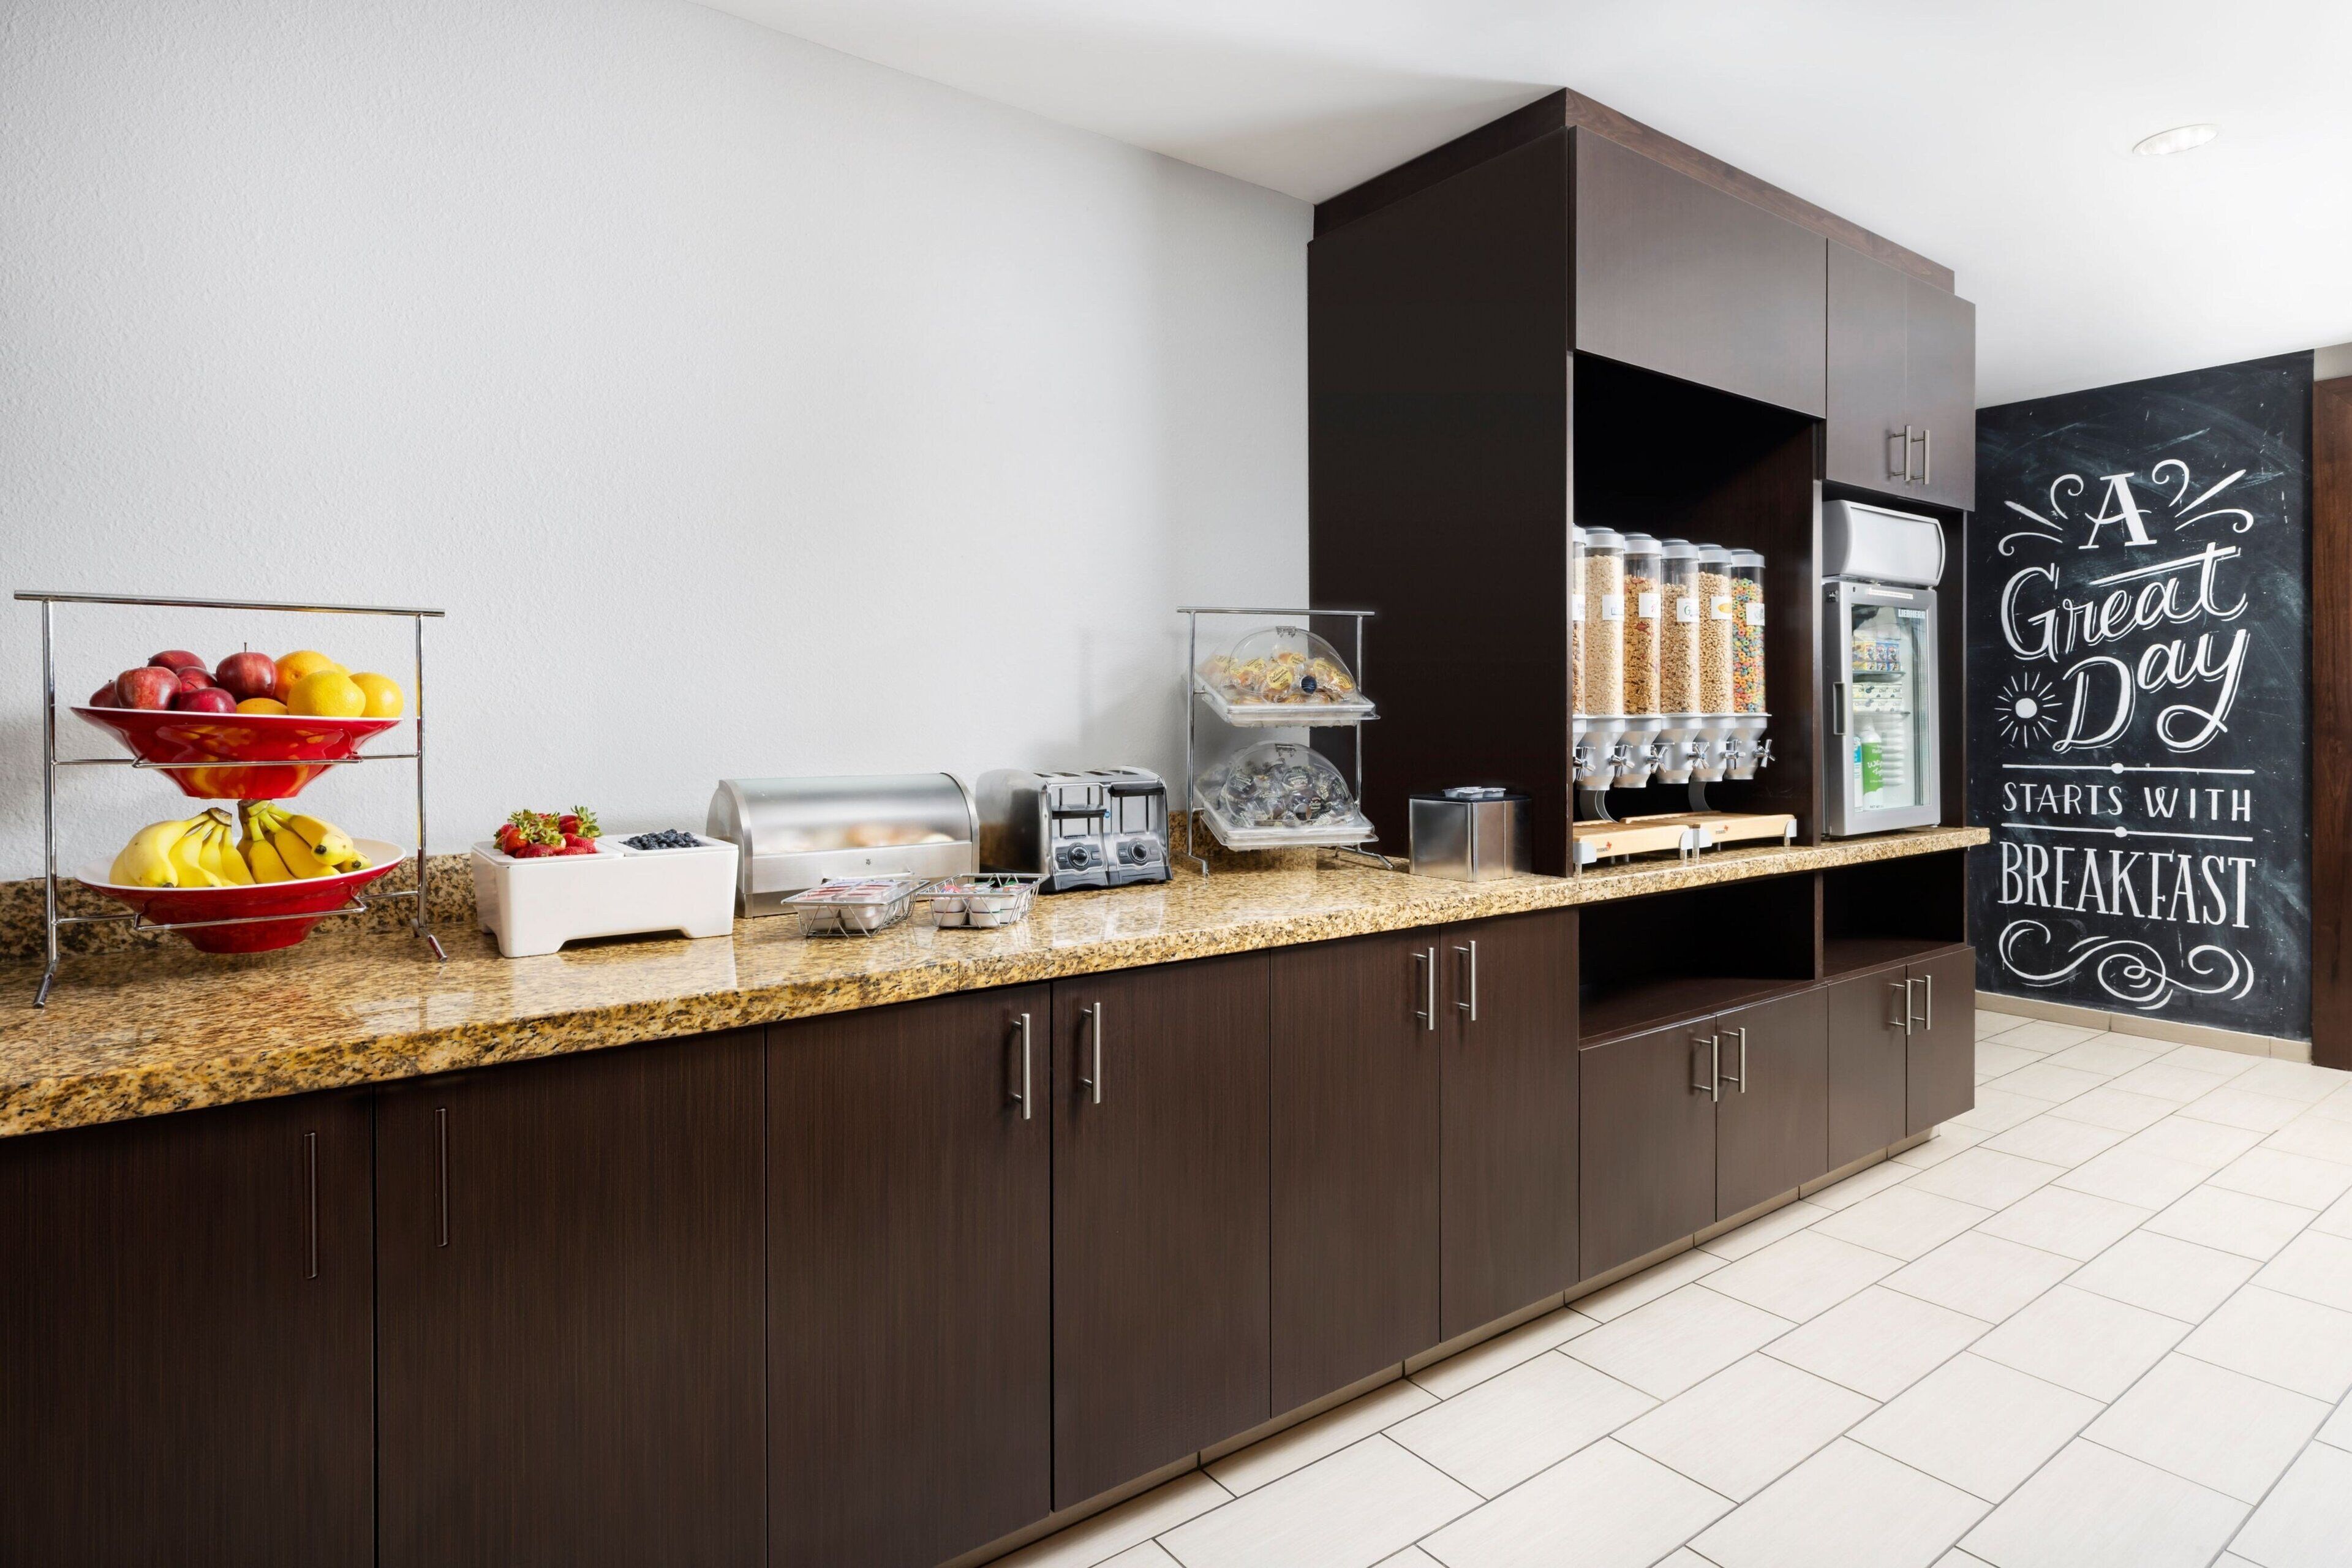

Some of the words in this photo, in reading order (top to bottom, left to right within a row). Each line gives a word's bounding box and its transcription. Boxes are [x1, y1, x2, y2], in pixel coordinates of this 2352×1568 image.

[2079, 472, 2157, 549] A
[2000, 541, 2248, 663] Great
[2052, 628, 2252, 753] Day
[2002, 782, 2123, 815] STARTS
[2144, 787, 2251, 822] WITH
[1997, 841, 2256, 929] BREAKFAST
